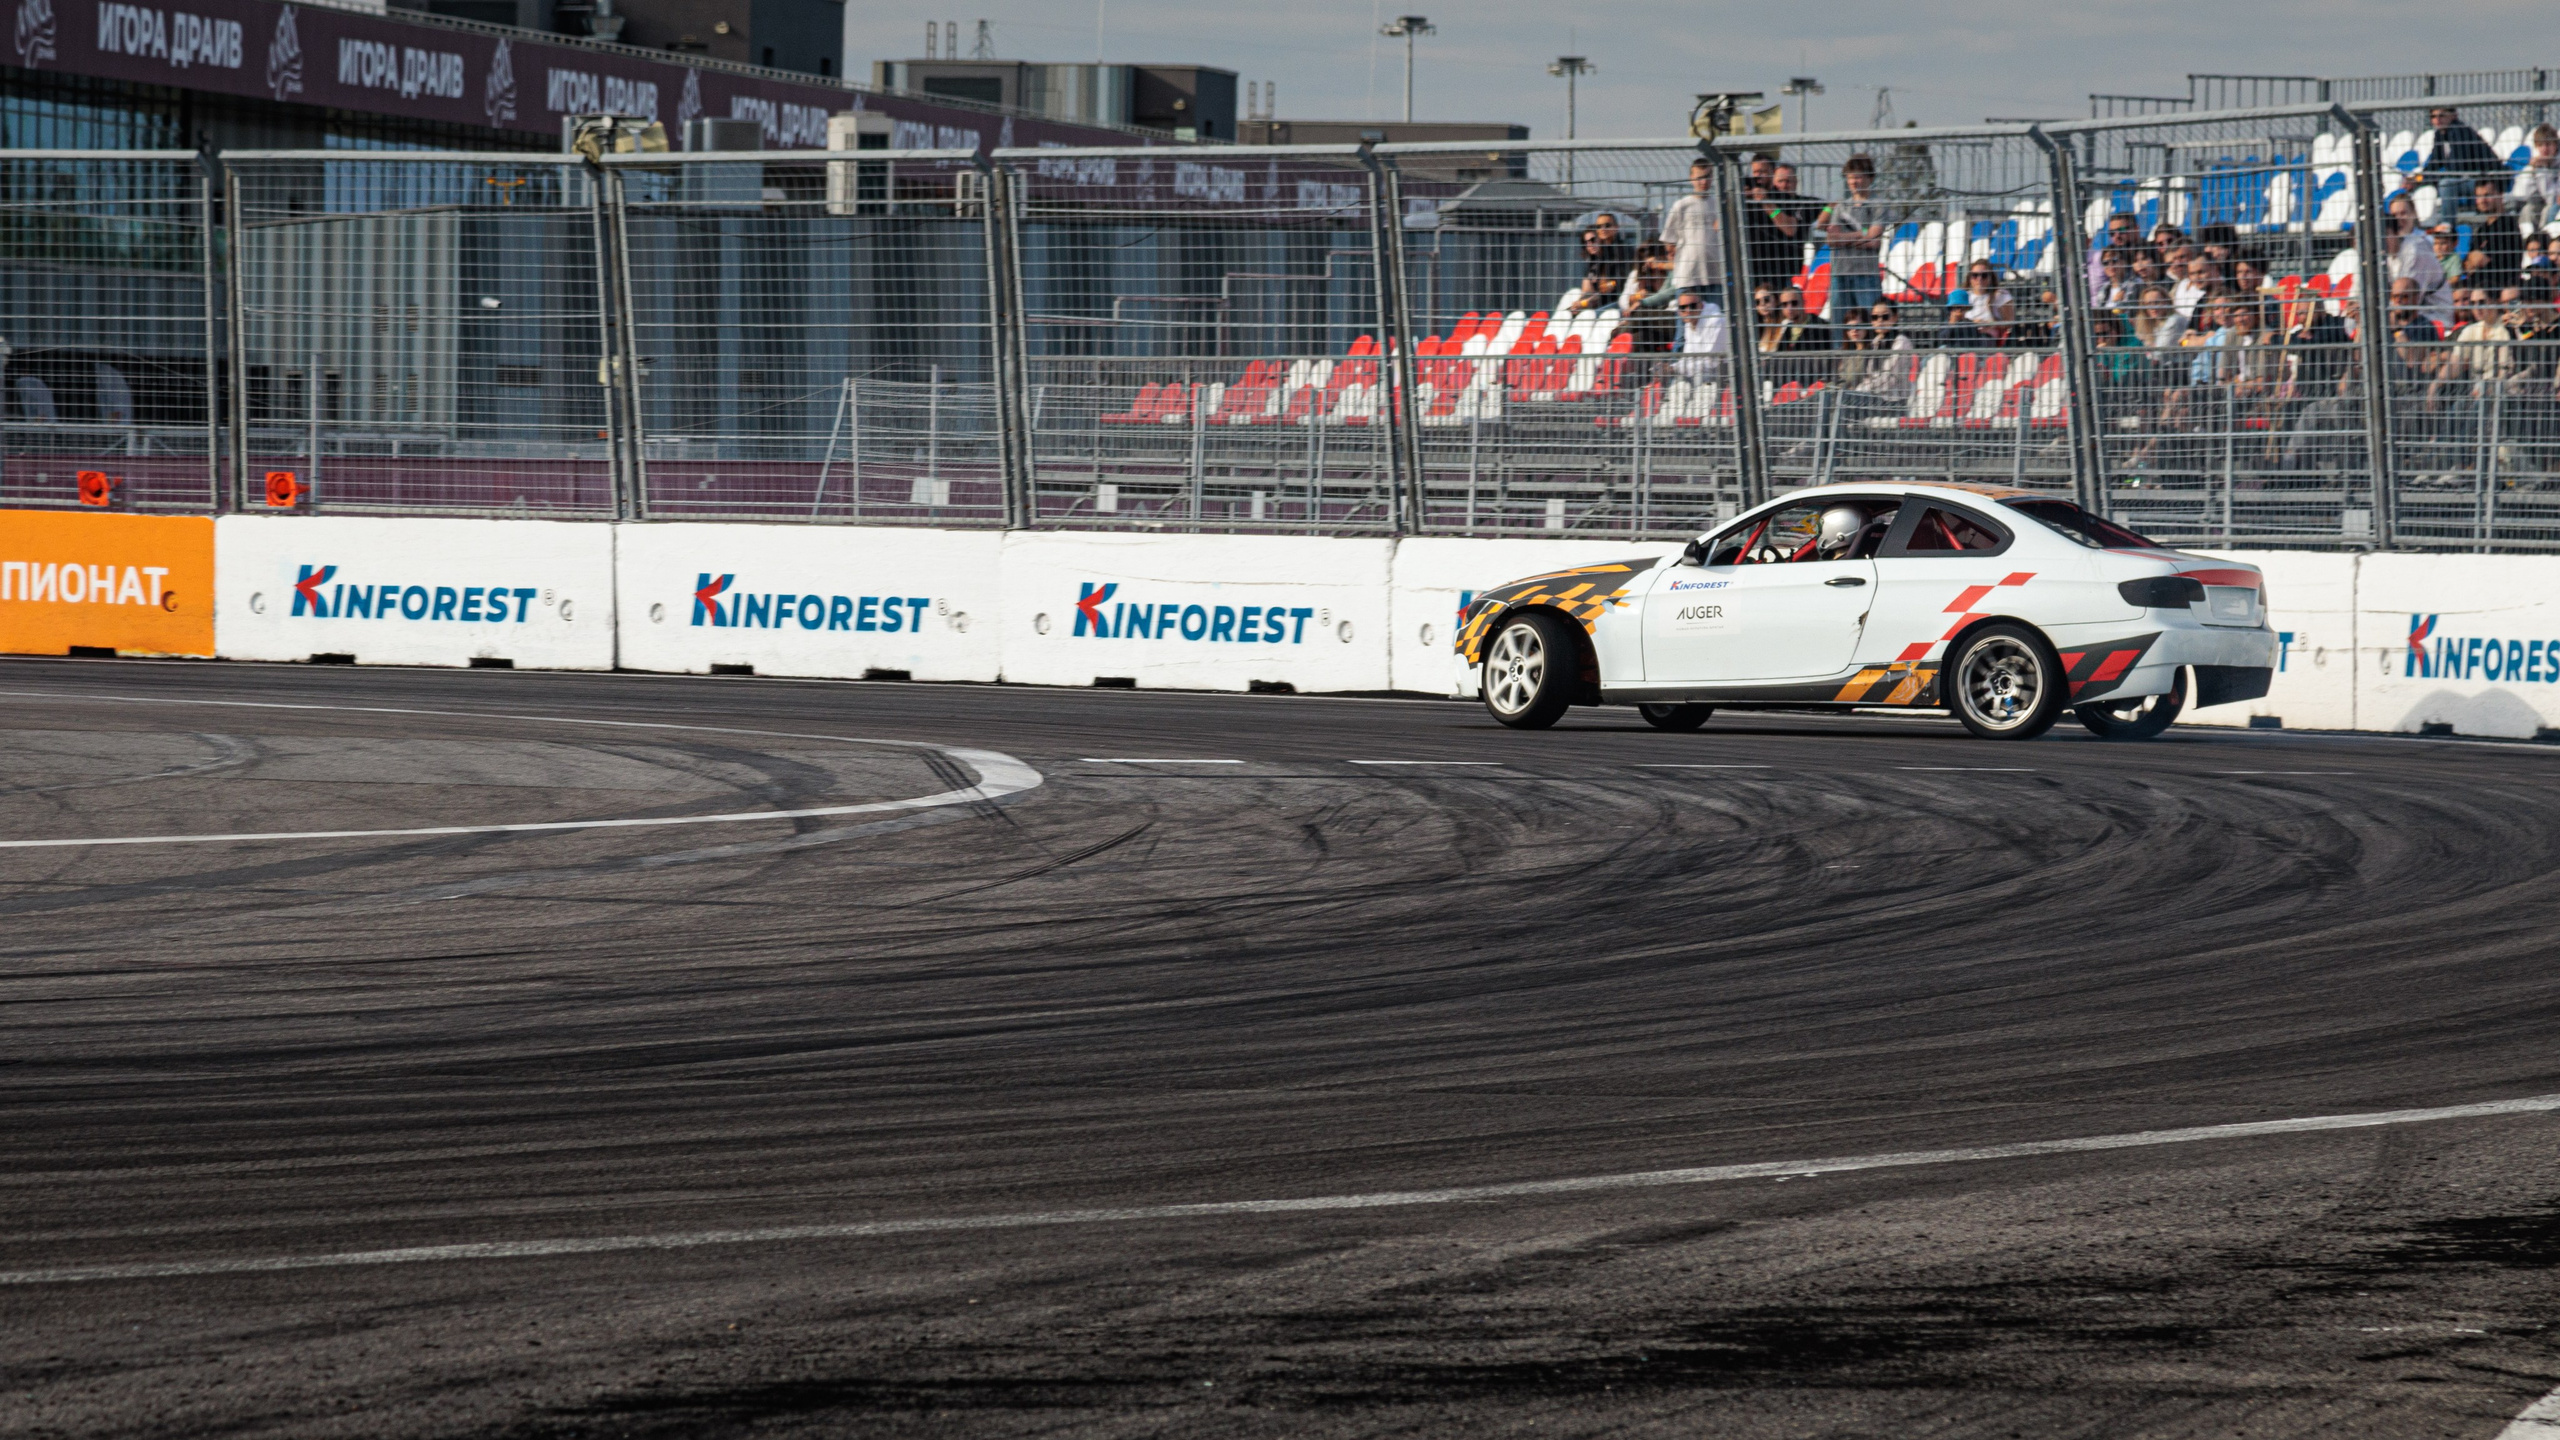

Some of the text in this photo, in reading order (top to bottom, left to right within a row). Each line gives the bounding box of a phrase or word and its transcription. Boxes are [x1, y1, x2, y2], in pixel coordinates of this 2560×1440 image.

[98, 2, 168, 59] ИГОРА
[338, 37, 399, 91] ИГОРА
[547, 67, 599, 115] ИГОРА
[2, 561, 169, 606] ПИОНАТ
[290, 564, 537, 623] KINFOREST
[690, 573, 930, 633] KINFOREST
[1669, 580, 1730, 591] KINFOREST
[1072, 582, 1314, 644] KINFOREST
[1676, 605, 1724, 620] AUGER
